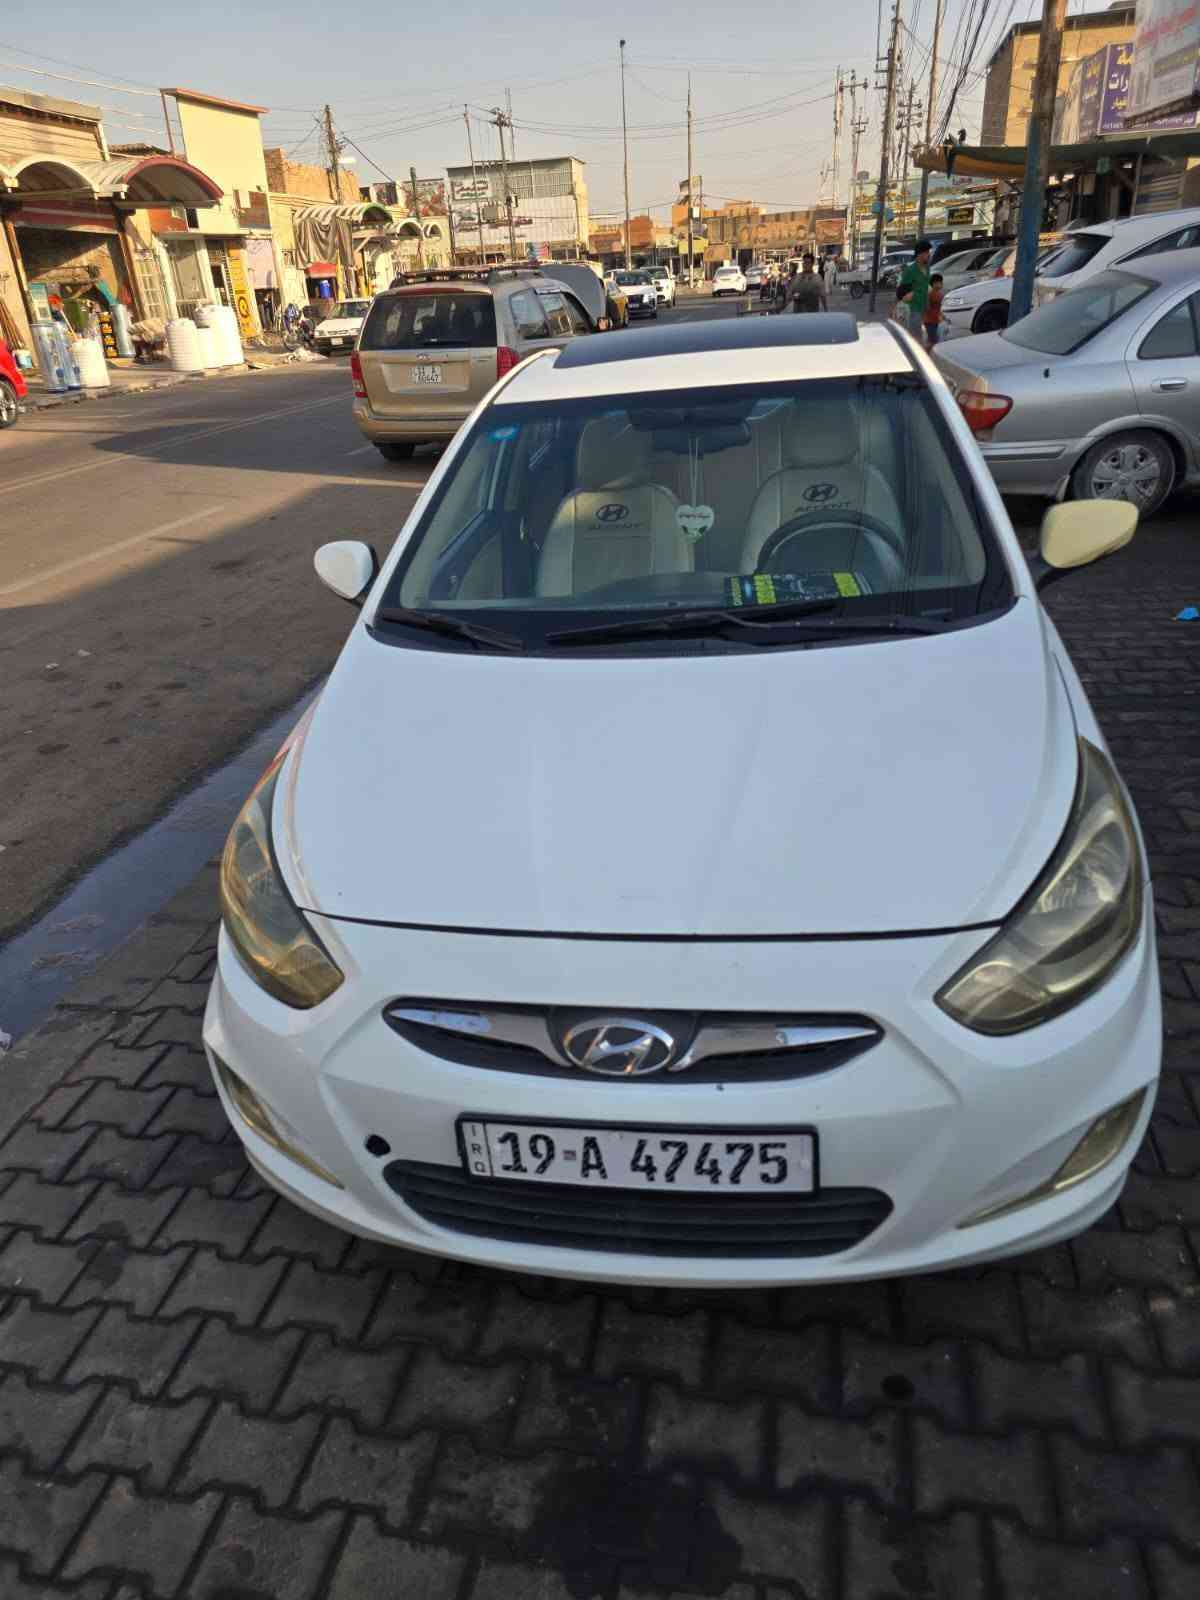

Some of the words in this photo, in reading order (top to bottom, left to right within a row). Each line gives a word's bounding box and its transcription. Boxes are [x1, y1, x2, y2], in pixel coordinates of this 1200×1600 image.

[471, 1125, 486, 1173] IRQ
[497, 1131, 556, 1175] 19
[580, 1136, 608, 1180] A
[630, 1138, 788, 1185] 47475
